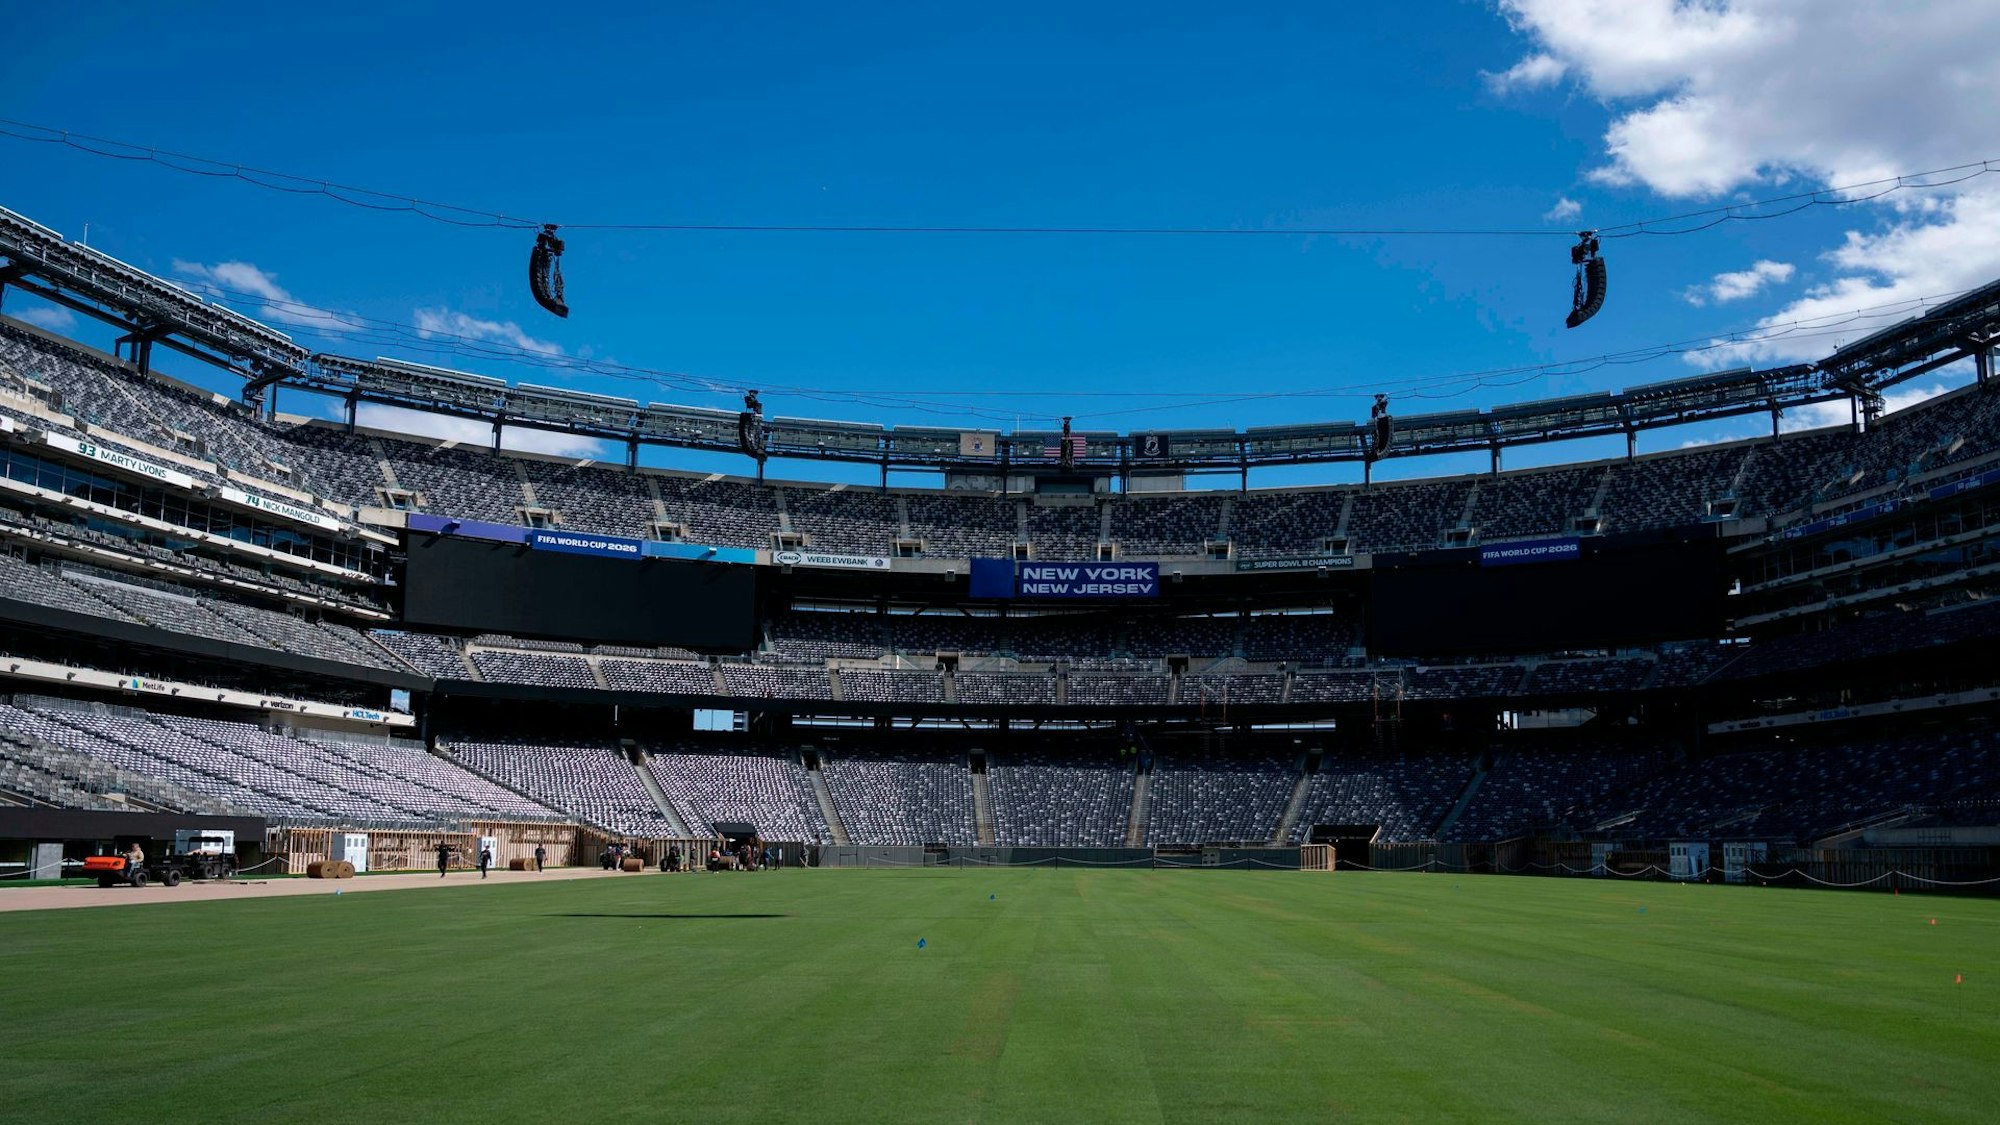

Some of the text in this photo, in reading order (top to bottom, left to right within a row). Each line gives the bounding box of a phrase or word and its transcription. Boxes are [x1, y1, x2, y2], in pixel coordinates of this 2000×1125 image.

[77, 442, 168, 478] 93 MARTY LYONS
[245, 494, 320, 524] 74 NICK MANGOLD
[537, 535, 638, 553] FIFA WORLD CUP 2026
[1483, 544, 1578, 559] FIFA WORLD CUP 2026
[807, 555, 868, 566] WEEB EWBANK
[1254, 560, 1278, 569] SUPER
[1278, 560, 1301, 568] BOWL
[1309, 557, 1352, 567] CHAMPIONS
[1023, 567, 1153, 580] NEW YORK
[1023, 583, 1153, 594] NEW JERSEY
[142, 681, 166, 691] MetLife
[270, 700, 294, 710] verizon
[352, 709, 380, 720] HCLTech
